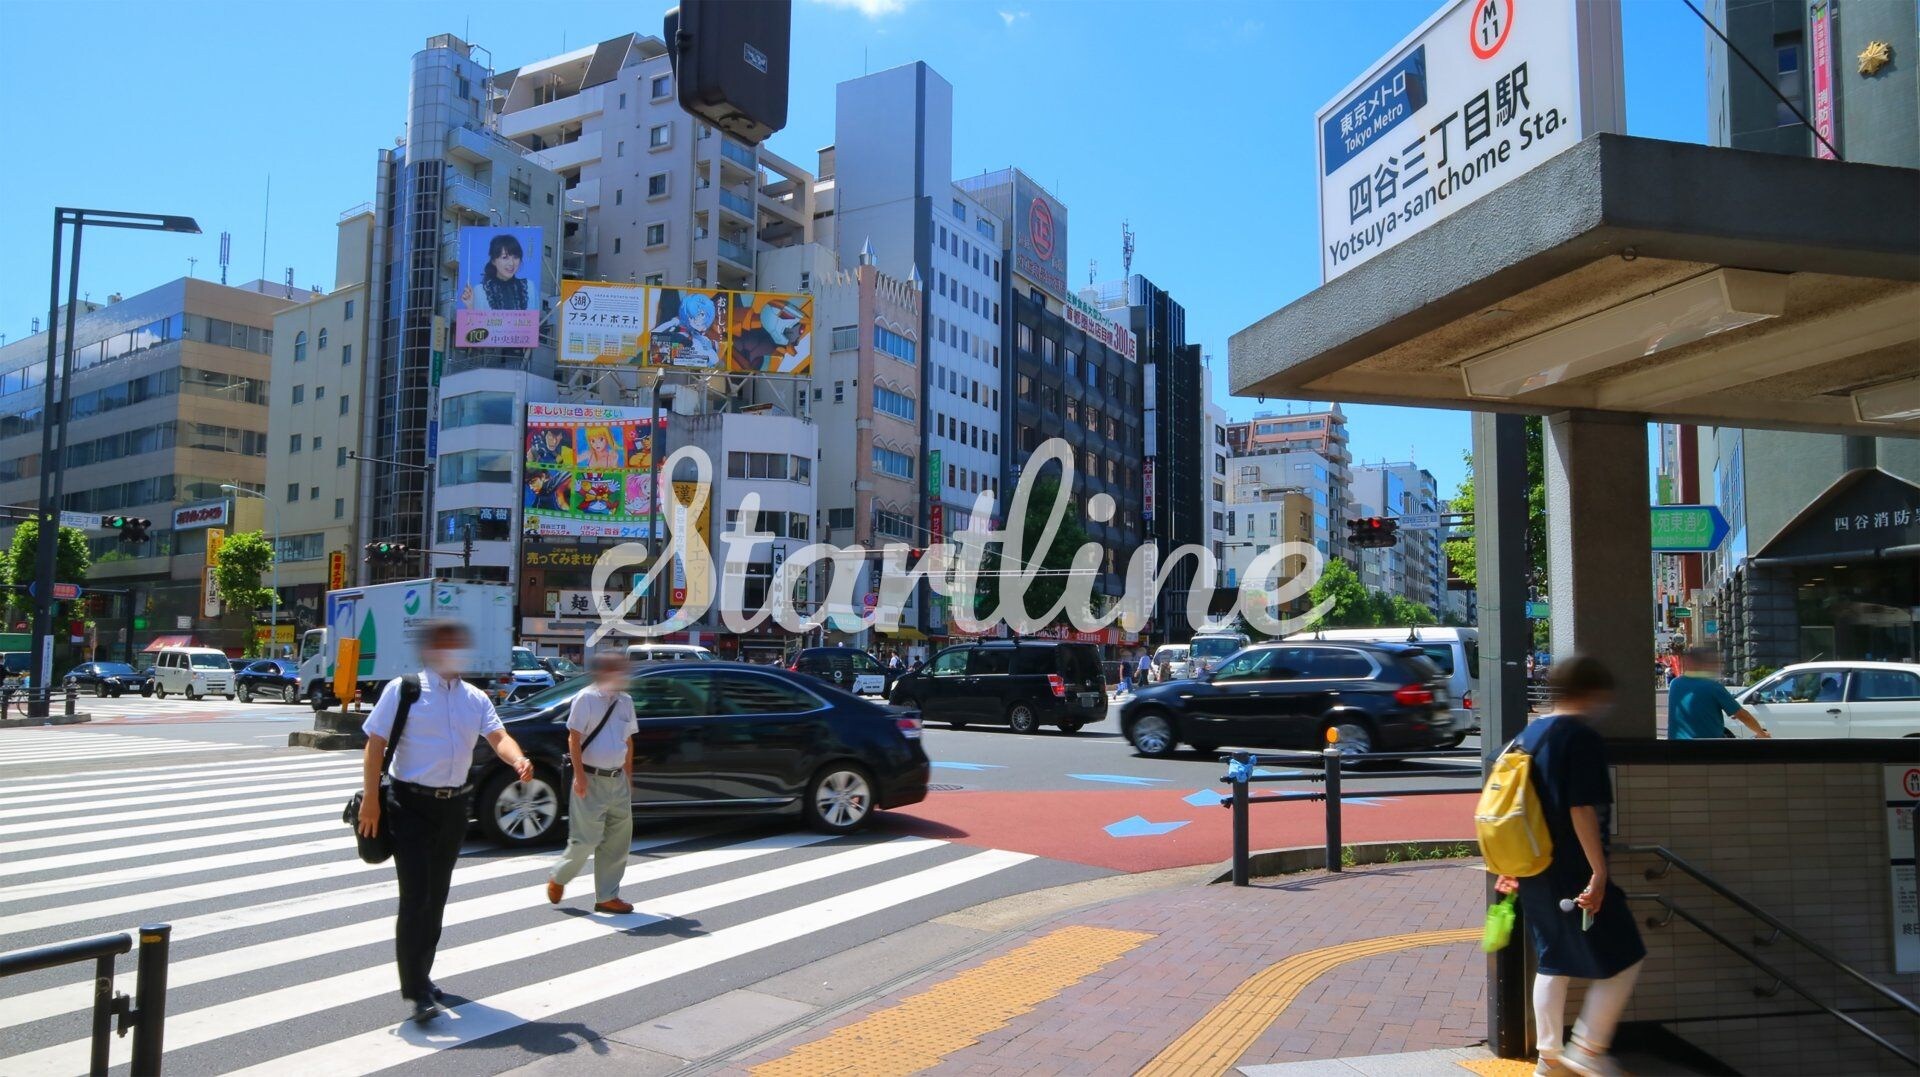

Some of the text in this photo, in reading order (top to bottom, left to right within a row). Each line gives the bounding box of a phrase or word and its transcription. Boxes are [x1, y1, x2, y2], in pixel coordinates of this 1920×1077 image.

[1482, 1, 1497, 24] M
[1482, 20, 1500, 46] 11
[1339, 69, 1407, 138] 東京メトロ
[1344, 102, 1404, 154] Tokyo Metro
[1349, 61, 1530, 226] 四谷三丁目駅
[1328, 106, 1568, 267] Yotsuya-sanchome Sta.
[529, 405, 623, 418] 「楽しい」は色あせない
